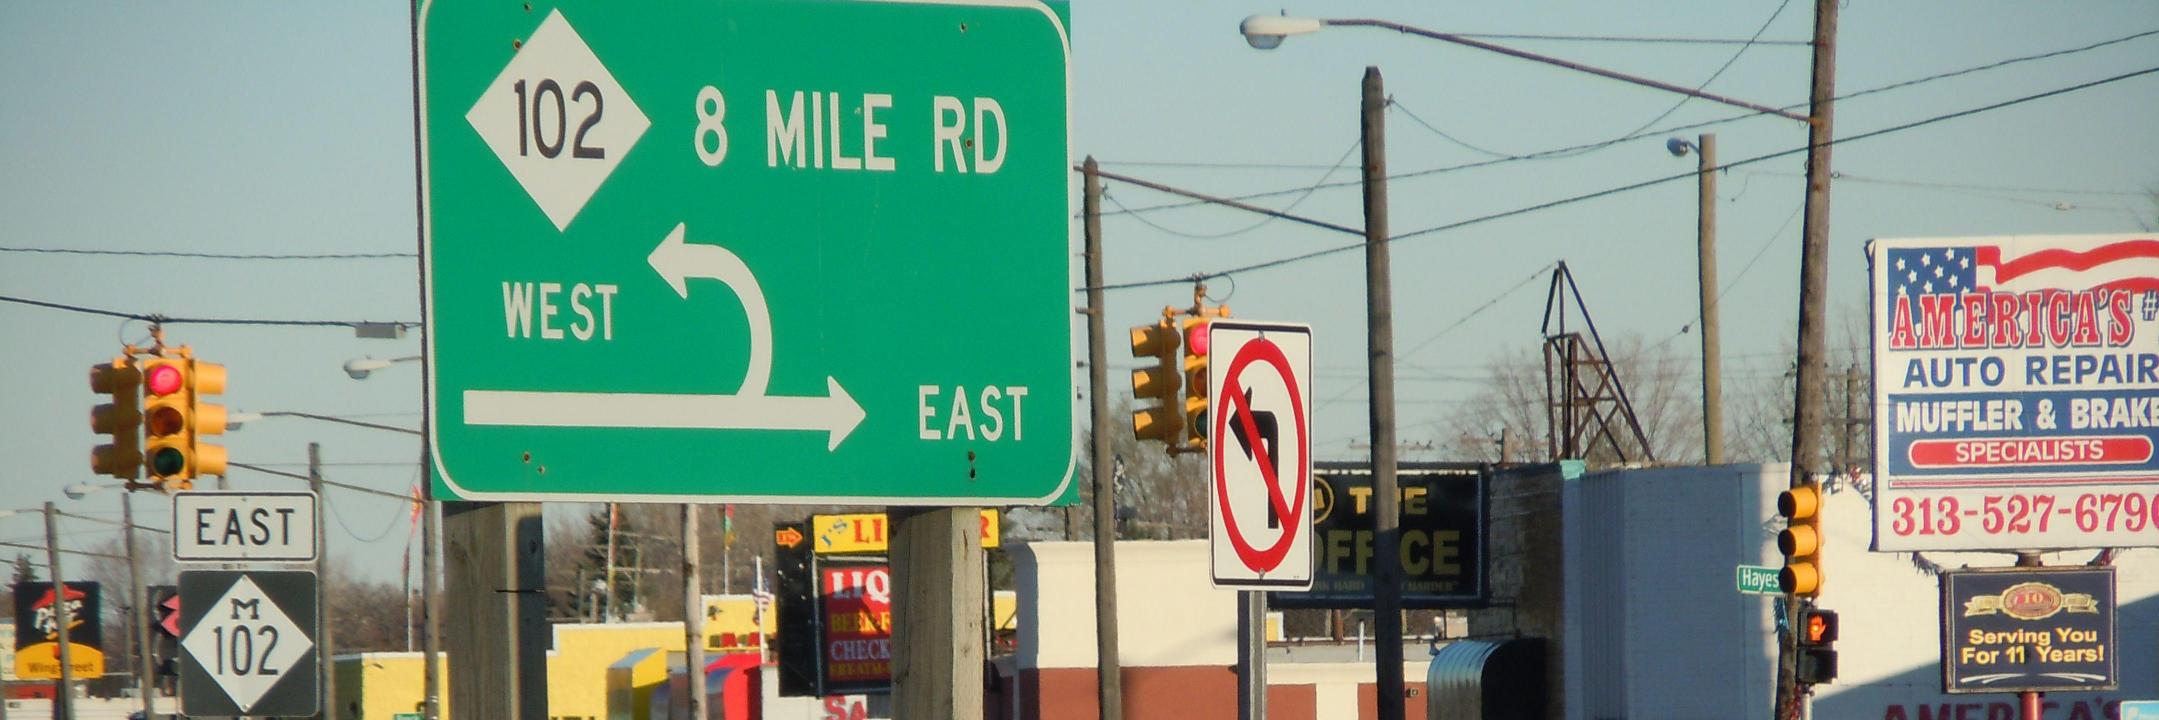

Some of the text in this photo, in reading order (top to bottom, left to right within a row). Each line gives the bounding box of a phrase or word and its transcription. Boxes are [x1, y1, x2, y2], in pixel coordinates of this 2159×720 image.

[513, 79, 605, 160] 102
[694, 85, 1008, 174] 8 MILE RD
[502, 281, 618, 341] WEST
[1889, 289, 2134, 350] AMERICA'S
[1904, 353, 2159, 388] AUTO REPAIR
[918, 385, 1028, 441] EAST
[1896, 399, 2022, 433] MUFFLER
[2037, 398, 2057, 429] &
[1955, 440, 2104, 462] SPECIALISTS
[1349, 487, 1428, 515] TE
[196, 508, 294, 545] EAST
[1743, 568, 1779, 590] Hayes
[230, 598, 259, 620] M
[213, 625, 279, 675] 102
[1969, 627, 2097, 646] Serving You
[1962, 645, 2105, 665] For 11 Years!
